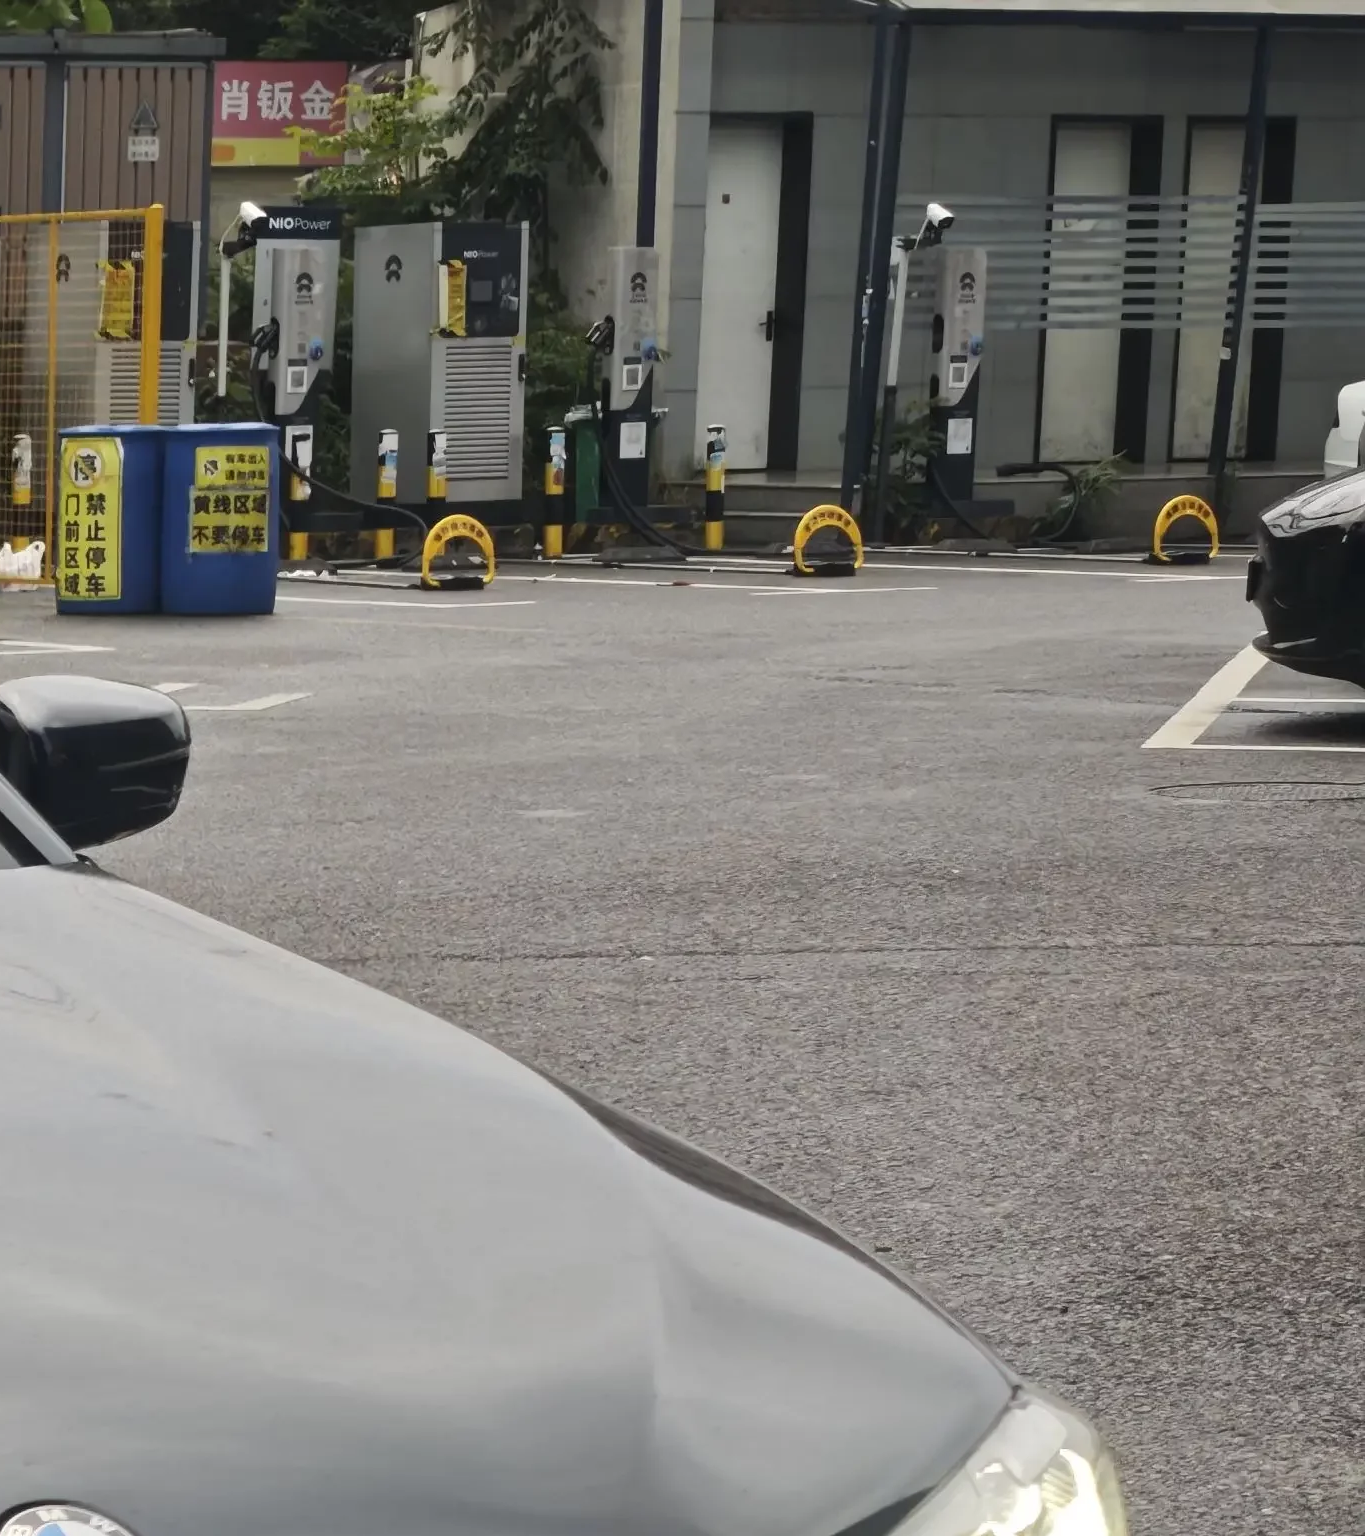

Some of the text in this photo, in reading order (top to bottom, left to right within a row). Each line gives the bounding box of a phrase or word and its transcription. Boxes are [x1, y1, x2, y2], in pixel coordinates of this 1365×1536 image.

[192, 525, 266, 547] 不要停车
[193, 494, 267, 516] 黄线区域
[64, 493, 81, 596] 门前区域
[85, 492, 107, 597] 禁止停车
